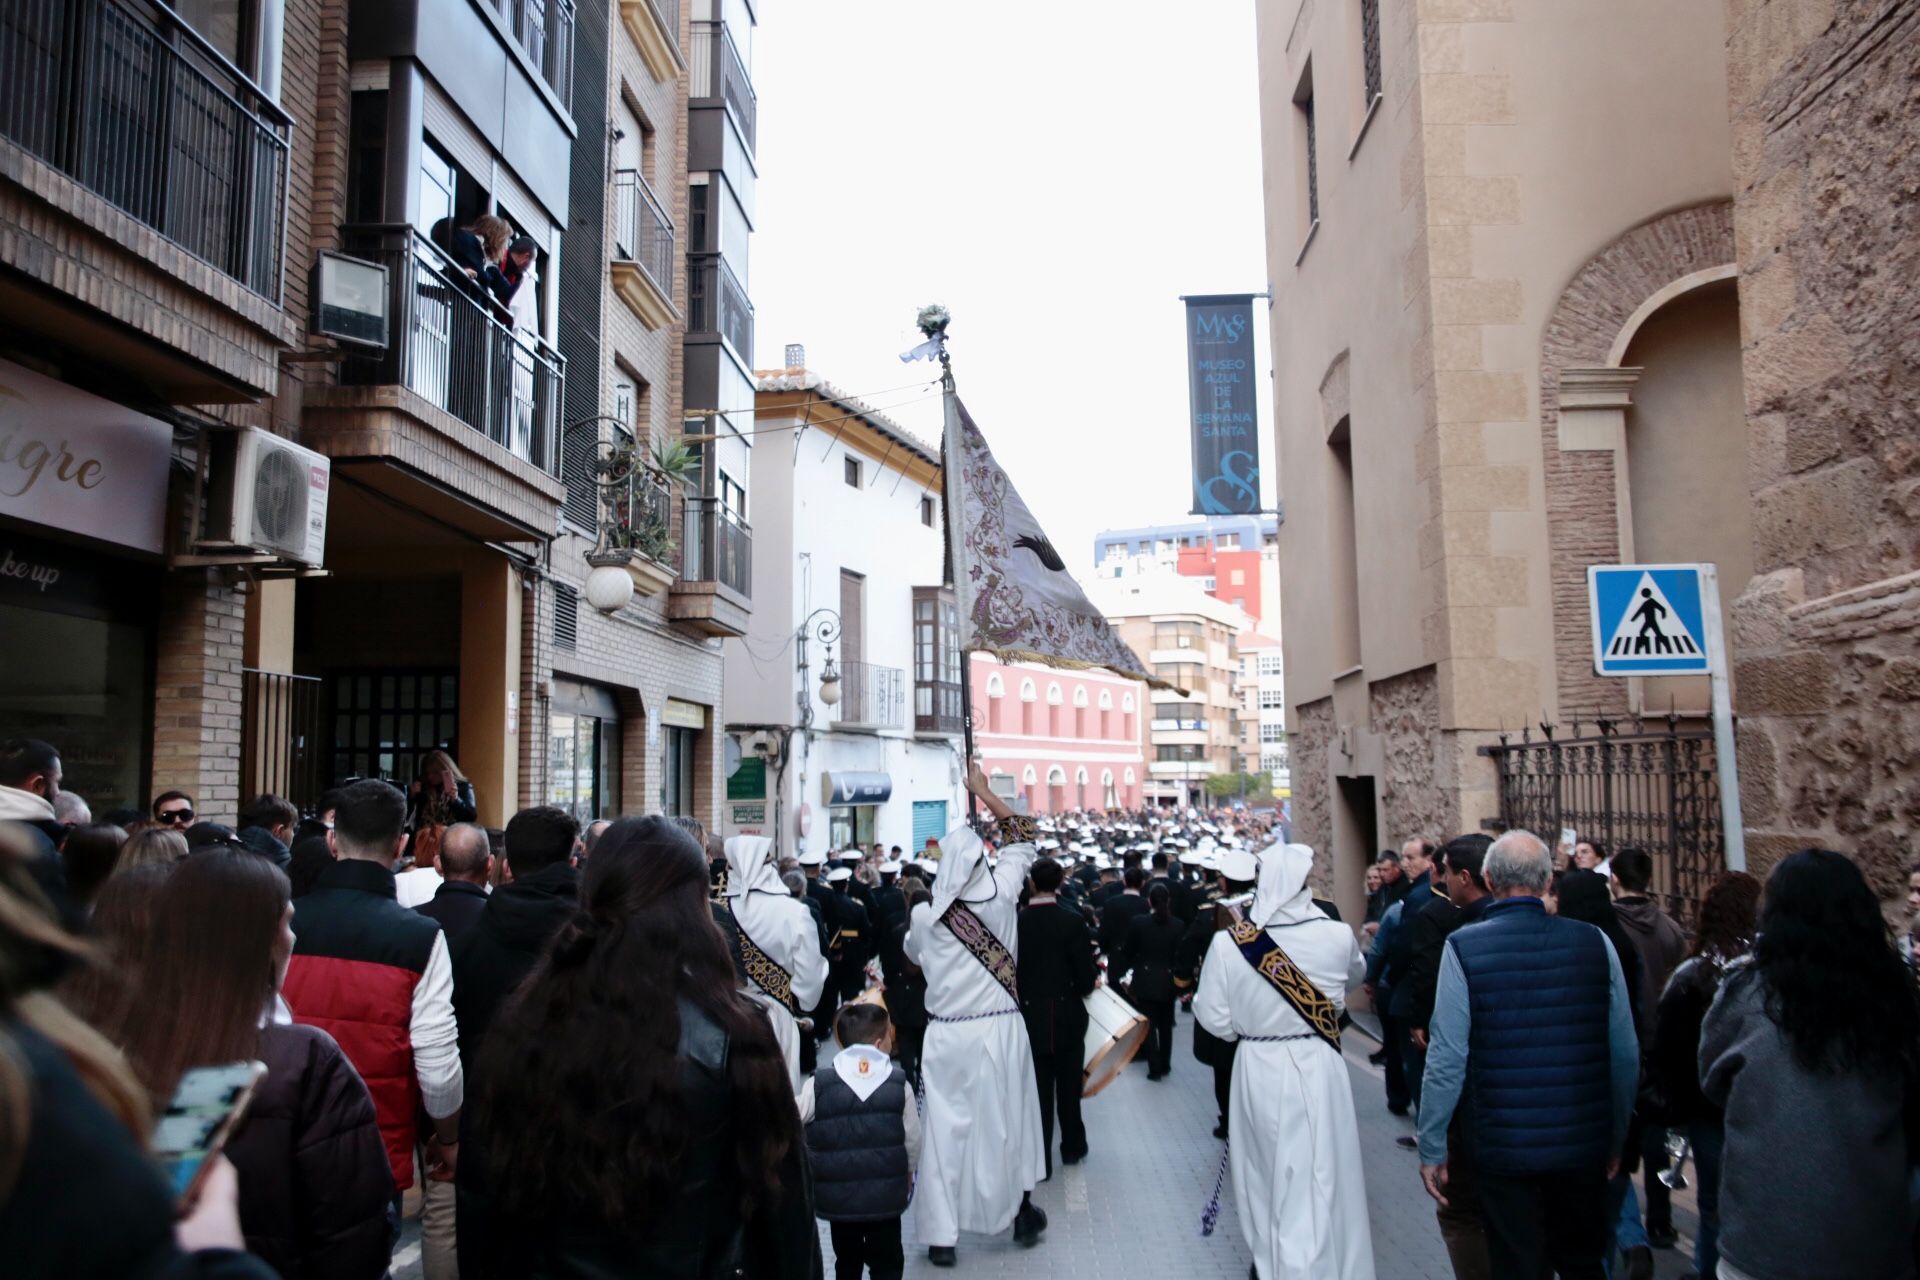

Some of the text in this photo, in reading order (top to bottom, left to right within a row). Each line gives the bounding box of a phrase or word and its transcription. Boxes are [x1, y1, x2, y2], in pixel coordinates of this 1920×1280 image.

[1199, 359, 1246, 370] MUSEO
[1204, 373, 1240, 383] AZUL
[1214, 386, 1232, 396] DE
[1215, 399, 1233, 409] LA
[1195, 413, 1253, 424] SEMANA
[1202, 426, 1248, 437] SANTA
[0, 400, 105, 497] igre
[312, 472, 326, 485] TCL
[0, 549, 61, 592] ke up
